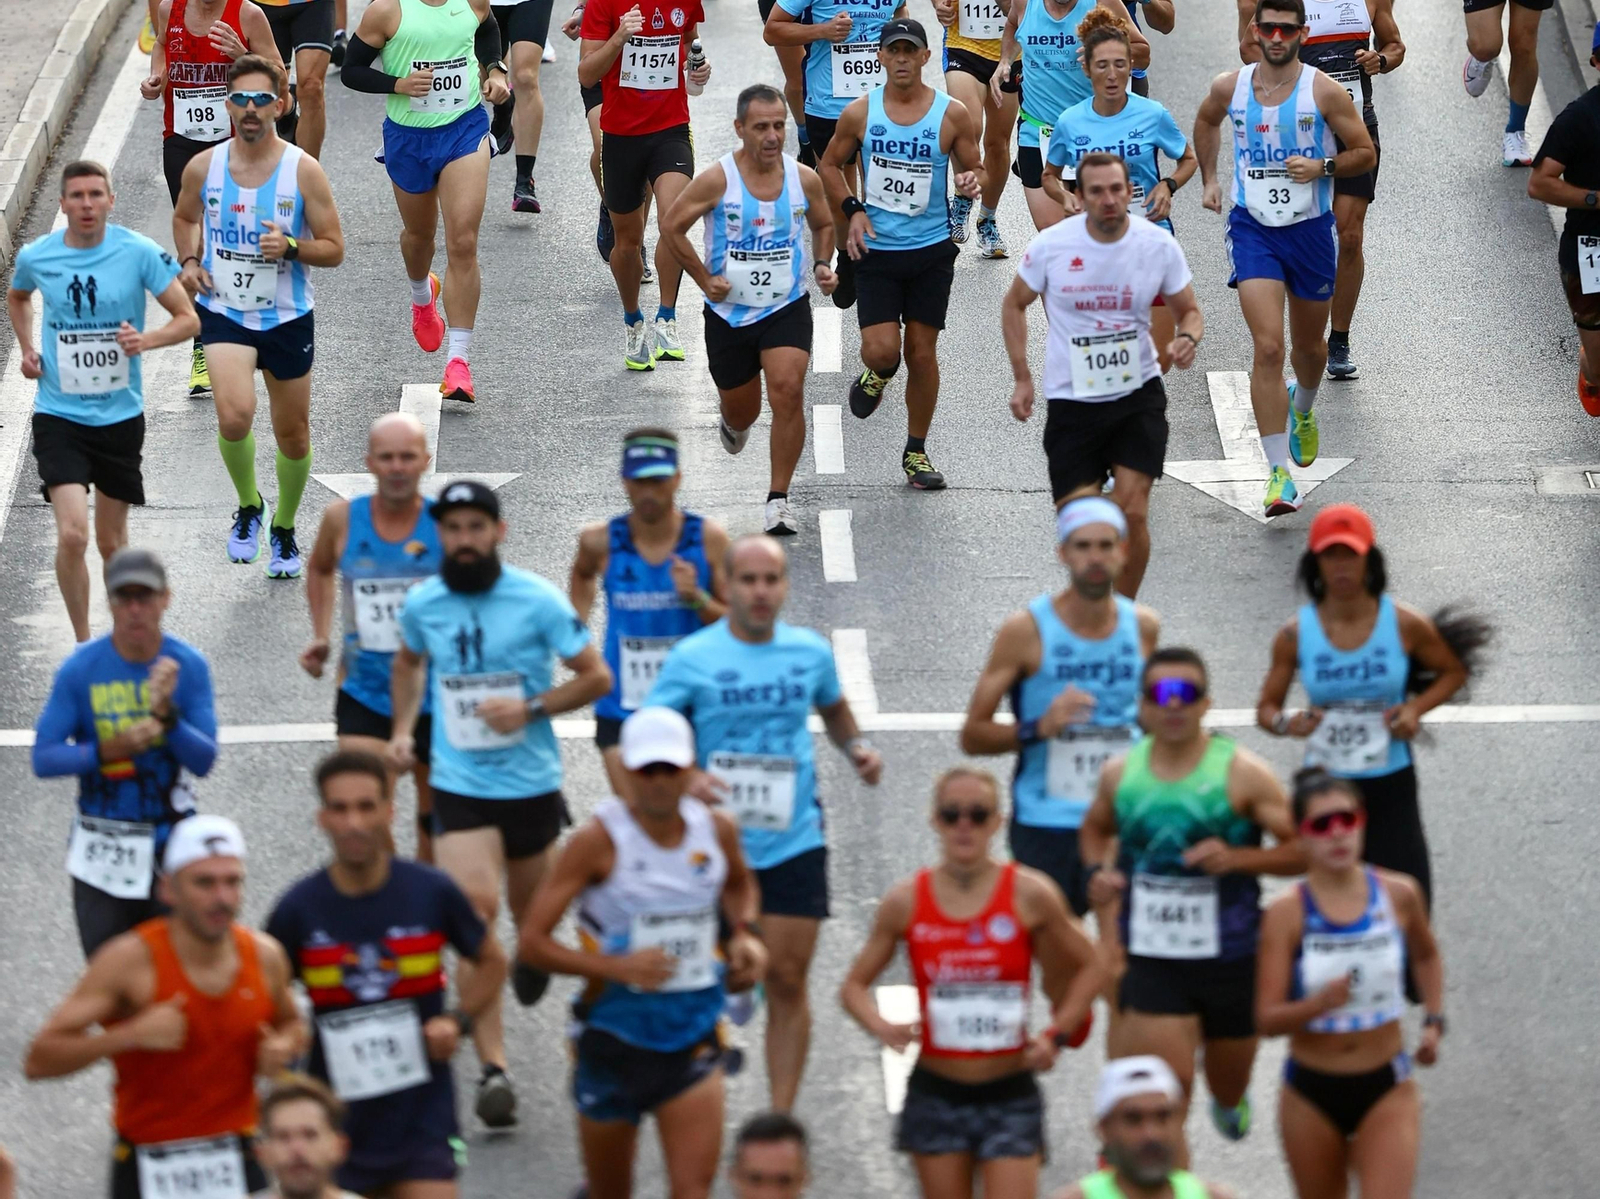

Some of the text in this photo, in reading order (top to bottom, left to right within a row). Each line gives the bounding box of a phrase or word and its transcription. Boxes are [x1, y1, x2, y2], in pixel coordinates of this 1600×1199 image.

[169, 25, 183, 34] vive
[628, 36, 644, 48] 43
[1027, 32, 1077, 49] nerja
[833, 44, 850, 55] 43
[629, 52, 677, 69] 11574
[843, 60, 882, 75] 6699
[432, 74, 462, 92] 600
[174, 89, 187, 100] 43
[186, 106, 216, 124] 198
[871, 136, 932, 160] nerja
[872, 155, 889, 169] 43
[1247, 169, 1265, 180] 43
[883, 177, 916, 197] 204
[1268, 188, 1291, 205] 33
[216, 248, 232, 261] 43
[730, 250, 748, 262] 43
[233, 271, 256, 290] 37
[750, 271, 772, 287] 32
[59, 333, 78, 345] 43
[71, 349, 119, 369] 1009
[1084, 349, 1130, 371] 1040
[1056, 655, 1135, 686] nerja
[1315, 656, 1389, 684] nerja
[721, 675, 808, 708] nerja
